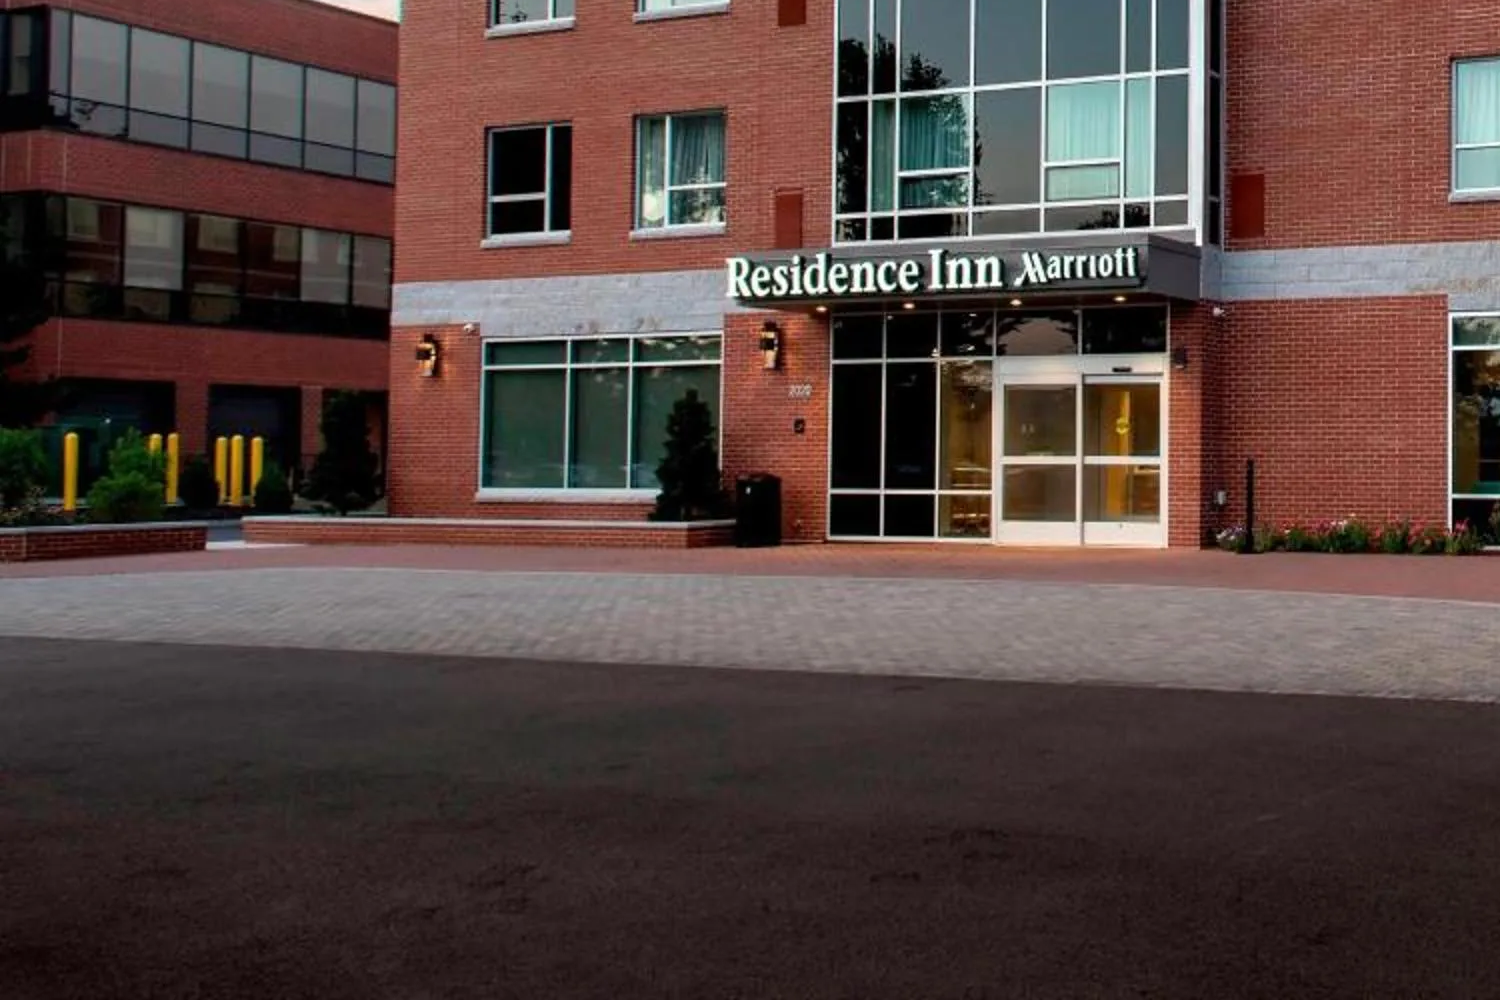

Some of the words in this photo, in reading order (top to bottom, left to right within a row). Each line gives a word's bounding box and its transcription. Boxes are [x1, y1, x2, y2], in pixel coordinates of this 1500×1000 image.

[725, 252, 920, 298] Residence
[927, 248, 1003, 290] Inn
[1013, 247, 1138, 288] Marriott
